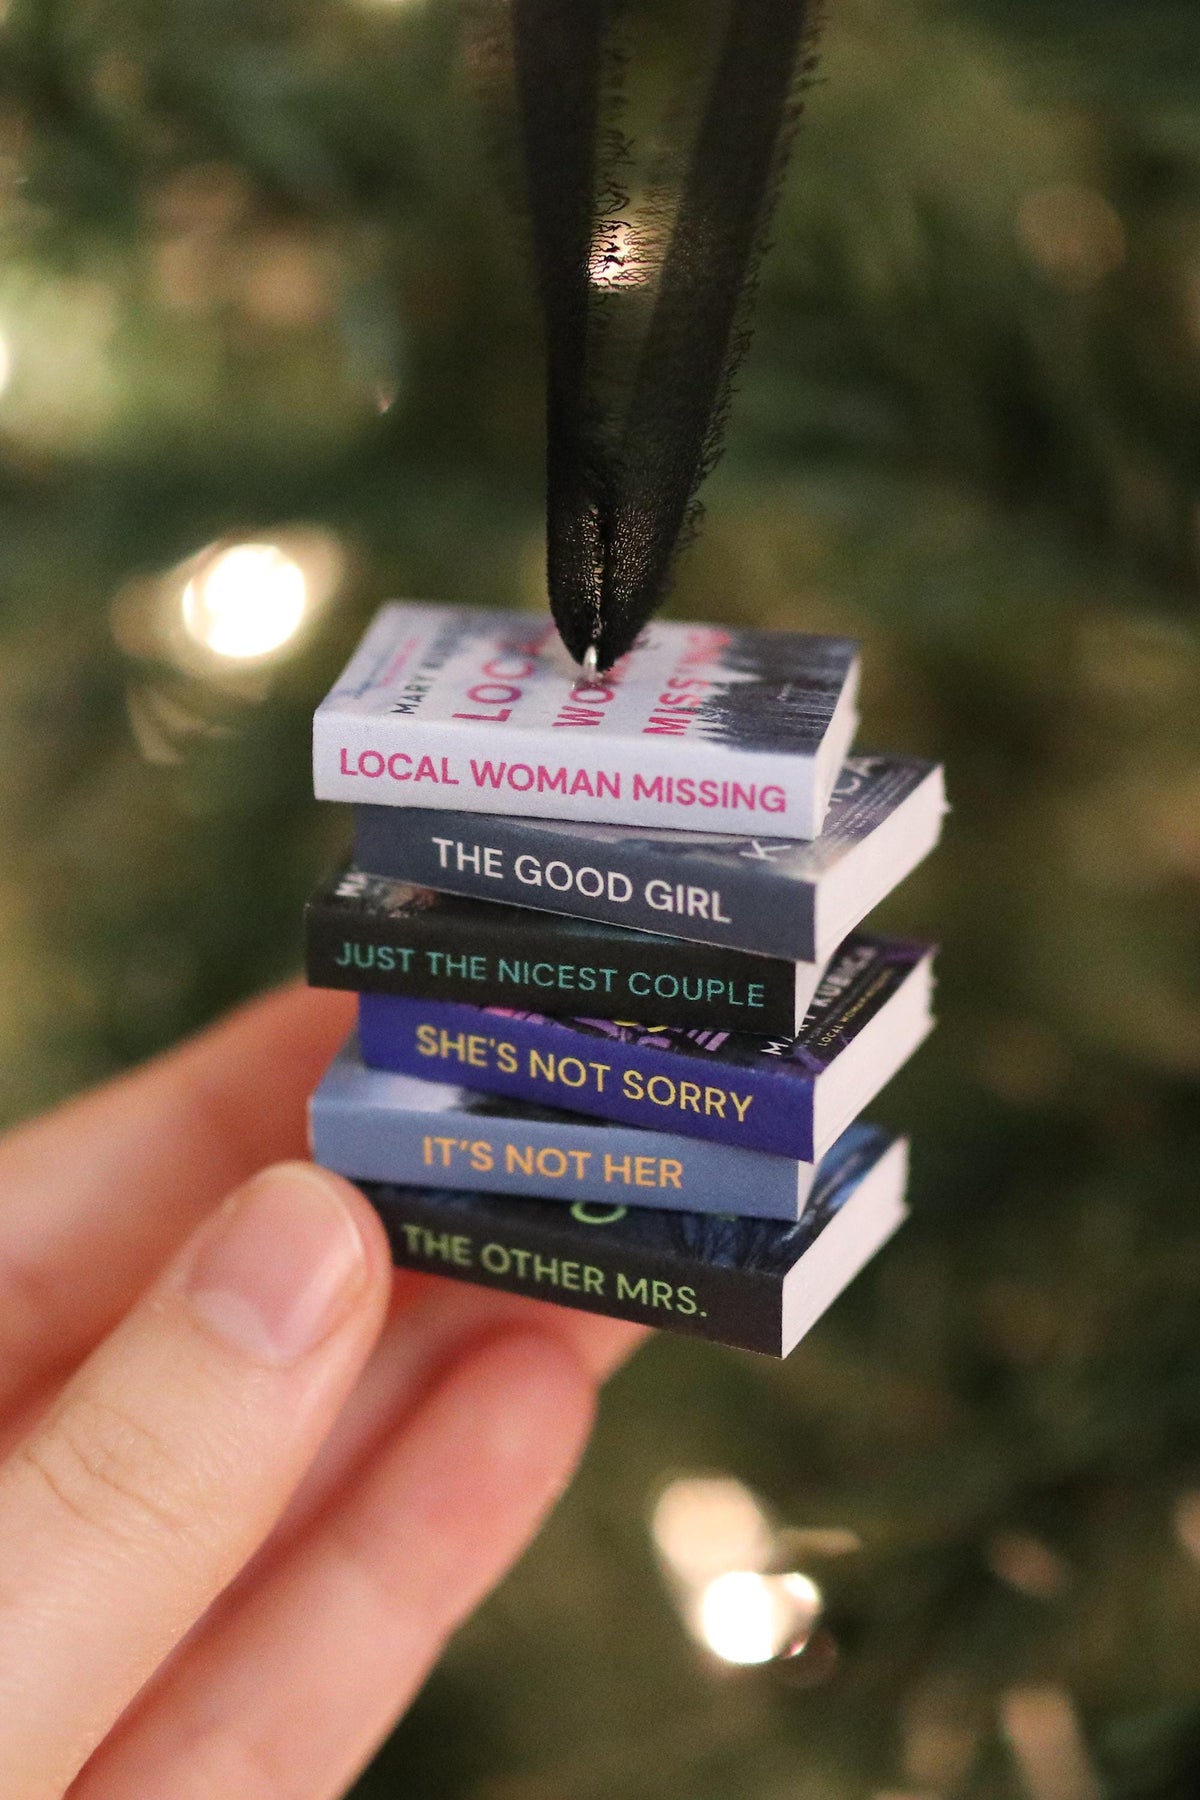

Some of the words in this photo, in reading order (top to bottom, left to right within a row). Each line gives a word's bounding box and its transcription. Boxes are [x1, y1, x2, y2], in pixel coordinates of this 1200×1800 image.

[340, 747, 459, 785] LOCAL
[470, 759, 621, 800] WOMAN
[633, 772, 787, 813] MISSING
[431, 836, 504, 879] THE
[514, 853, 633, 903] GOOD
[645, 880, 732, 924] GIRL
[336, 942, 415, 975] JUST
[426, 952, 488, 982] THE
[498, 960, 619, 994] NICEST
[628, 971, 766, 1009] COUPLE
[817, 1024, 844, 1047] LOCAL
[415, 1024, 519, 1072] SHE'S
[529, 1049, 612, 1093] NOT
[623, 1070, 754, 1123] SORRY
[423, 1137, 495, 1172] IT'S
[505, 1146, 591, 1182] NOT
[604, 1155, 683, 1190] HER
[402, 1223, 473, 1267] THE
[481, 1245, 606, 1296] OTHER
[616, 1272, 708, 1318] MRS.
